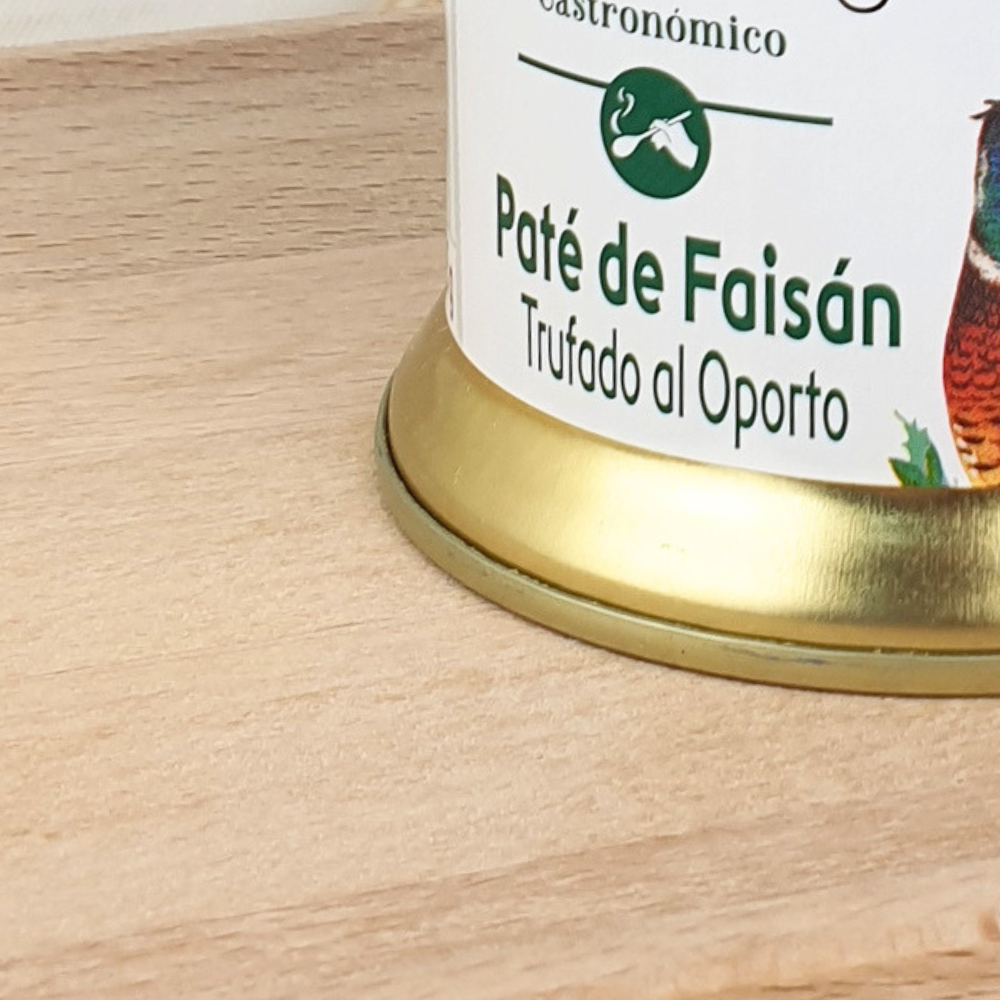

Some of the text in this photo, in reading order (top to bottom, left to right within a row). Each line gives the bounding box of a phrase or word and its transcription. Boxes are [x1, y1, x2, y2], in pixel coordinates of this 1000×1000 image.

[496, 173, 901, 348] Paté de Faisán
[520, 292, 641, 405] Trufado
[653, 344, 684, 418] al
[700, 349, 849, 449] Oporto
